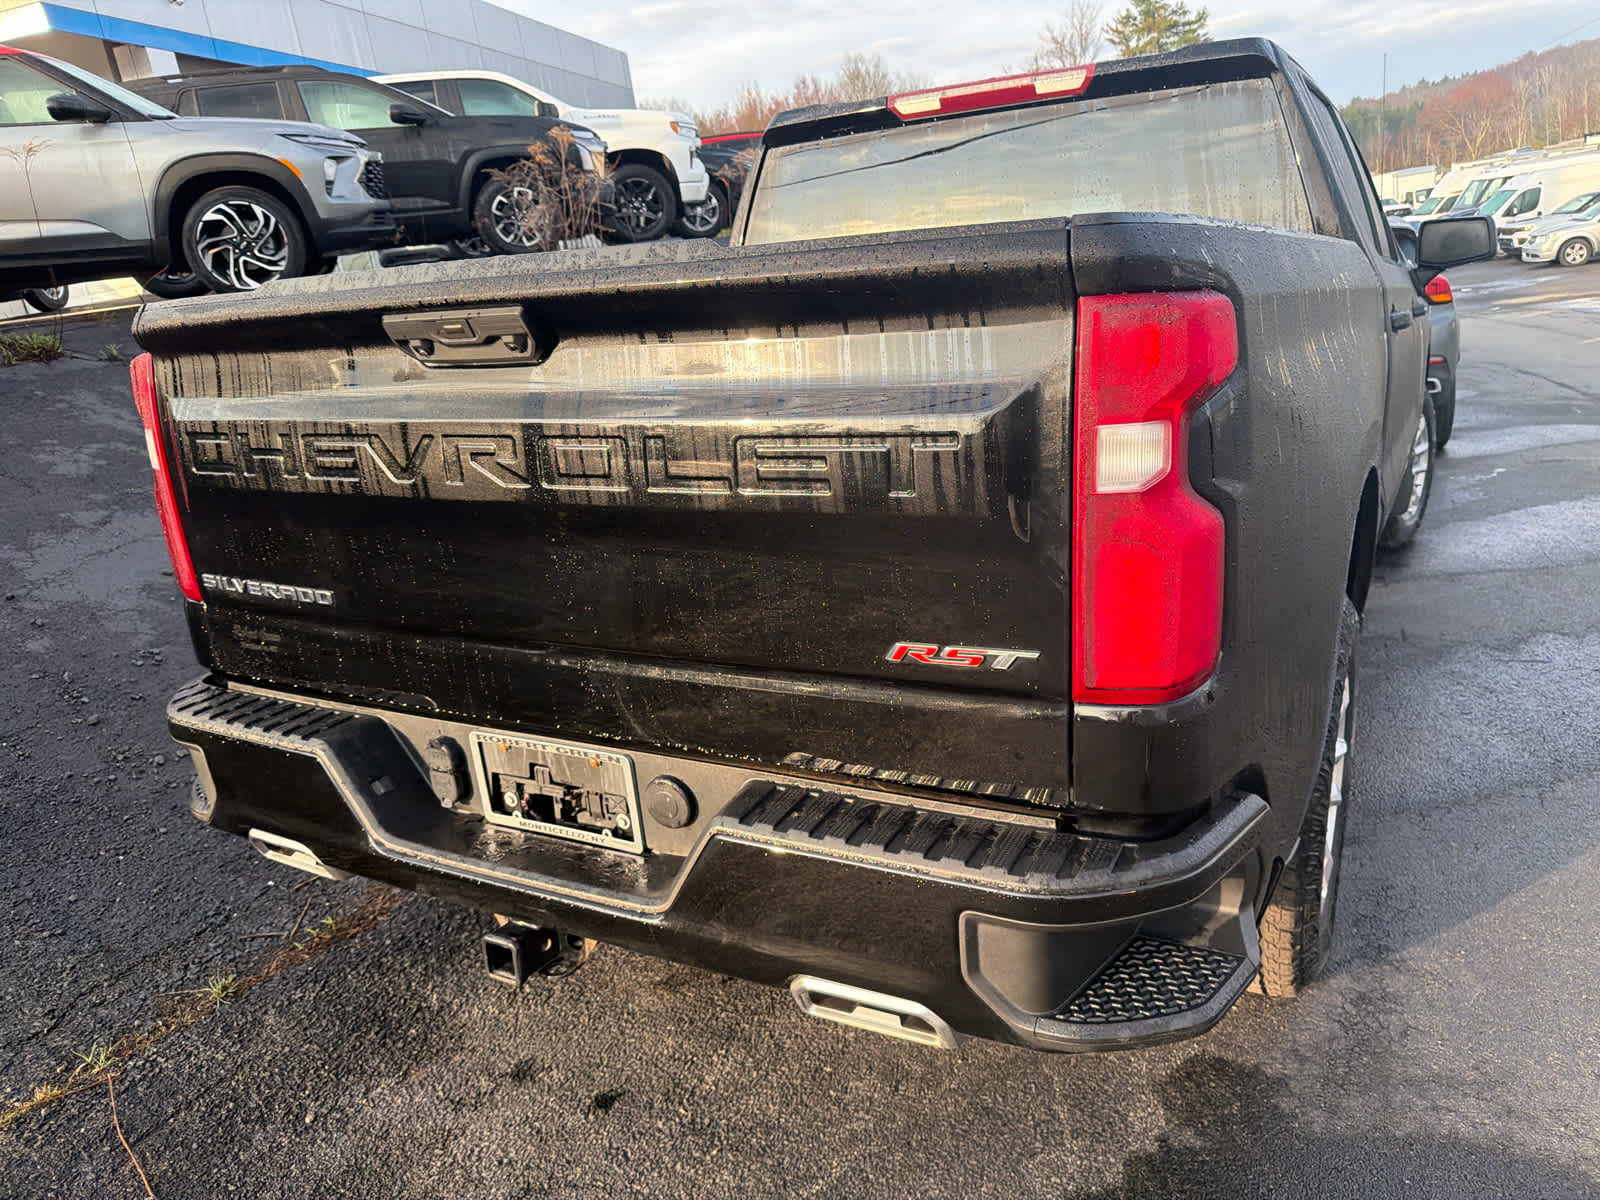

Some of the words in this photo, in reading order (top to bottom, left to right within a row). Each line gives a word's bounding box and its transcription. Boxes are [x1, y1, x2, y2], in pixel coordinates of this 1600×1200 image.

[187, 430, 962, 498] CHEVROLET
[201, 573, 335, 606] SILVERADO
[885, 642, 1041, 671] RST
[475, 733, 547, 750] ROBERT
[556, 747, 622, 764] GREEN
